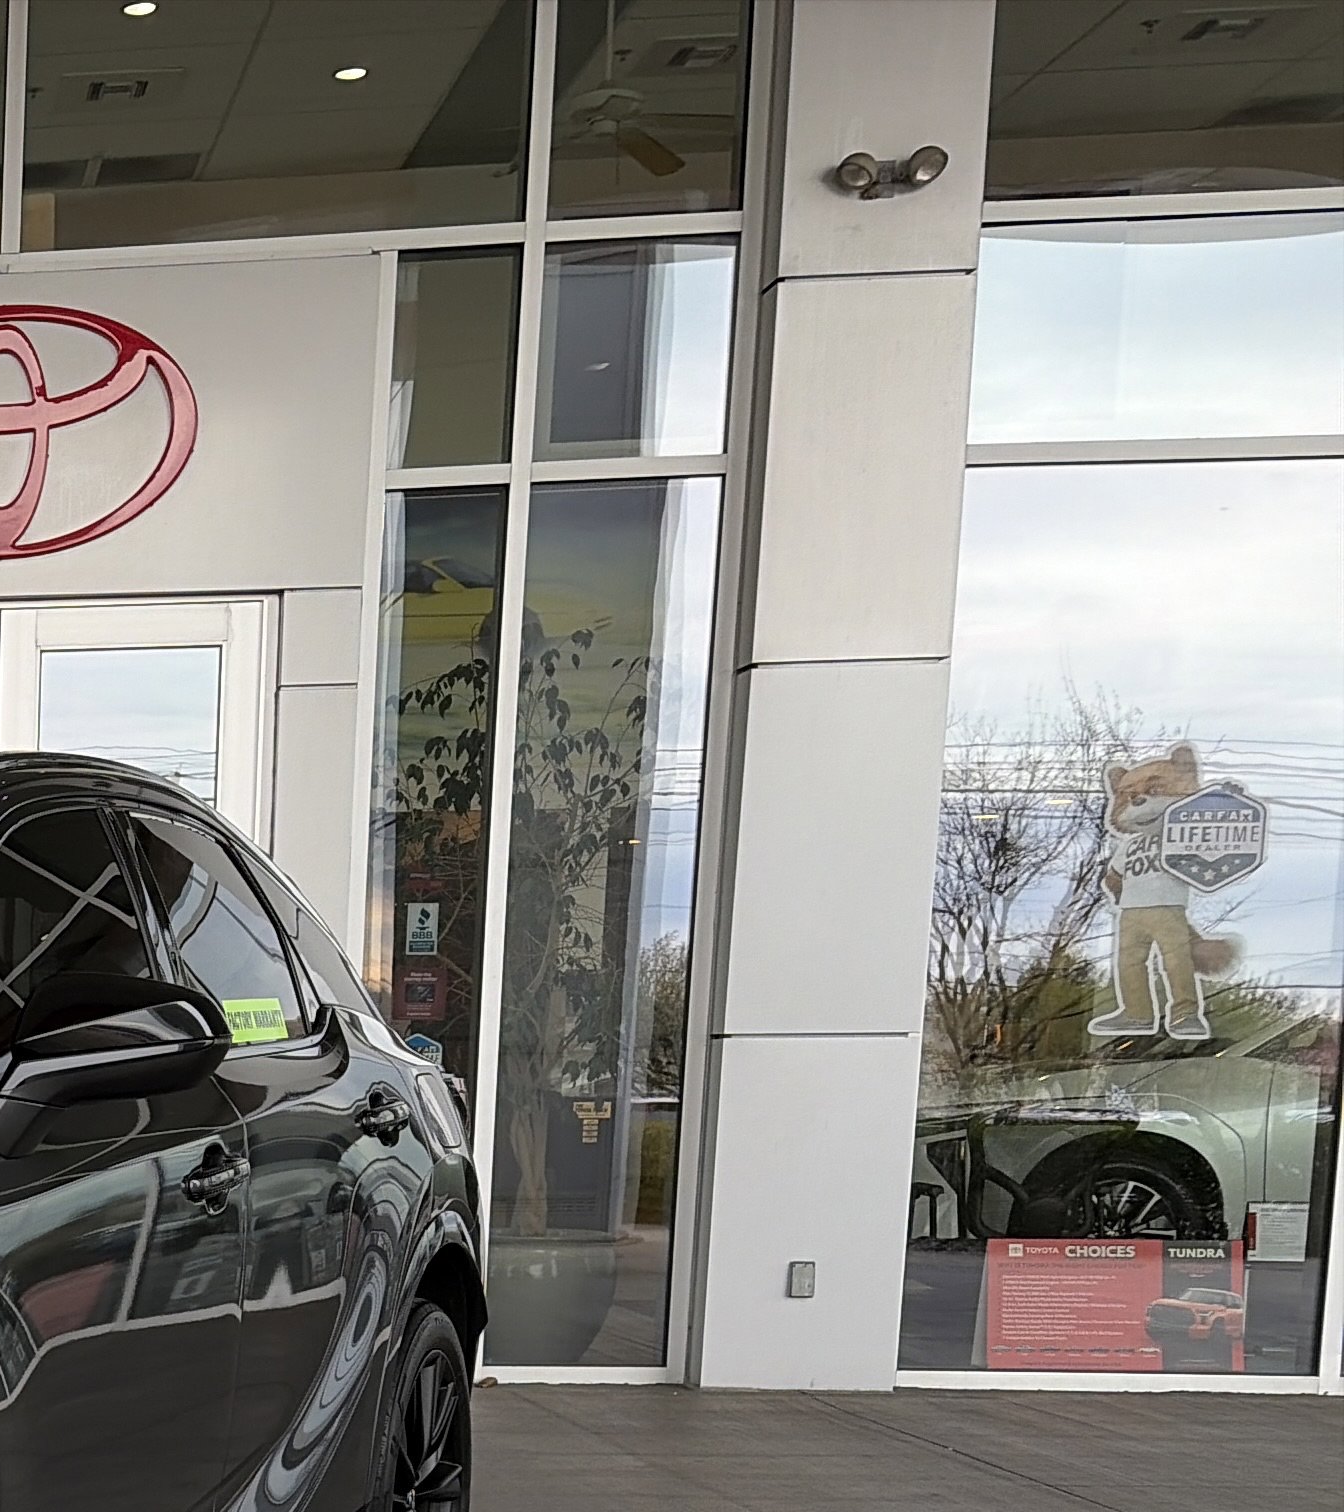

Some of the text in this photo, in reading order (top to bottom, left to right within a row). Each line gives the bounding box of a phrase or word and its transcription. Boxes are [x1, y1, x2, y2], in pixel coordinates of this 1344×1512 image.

[1179, 809, 1253, 822] CARFAX
[1166, 825, 1261, 843] LIFETIME
[1123, 854, 1161, 880] FOX
[411, 931, 434, 940] BBB
[1025, 1245, 1136, 1259] TOYOTA CHOICES
[1168, 1248, 1226, 1259] TUNDRA
